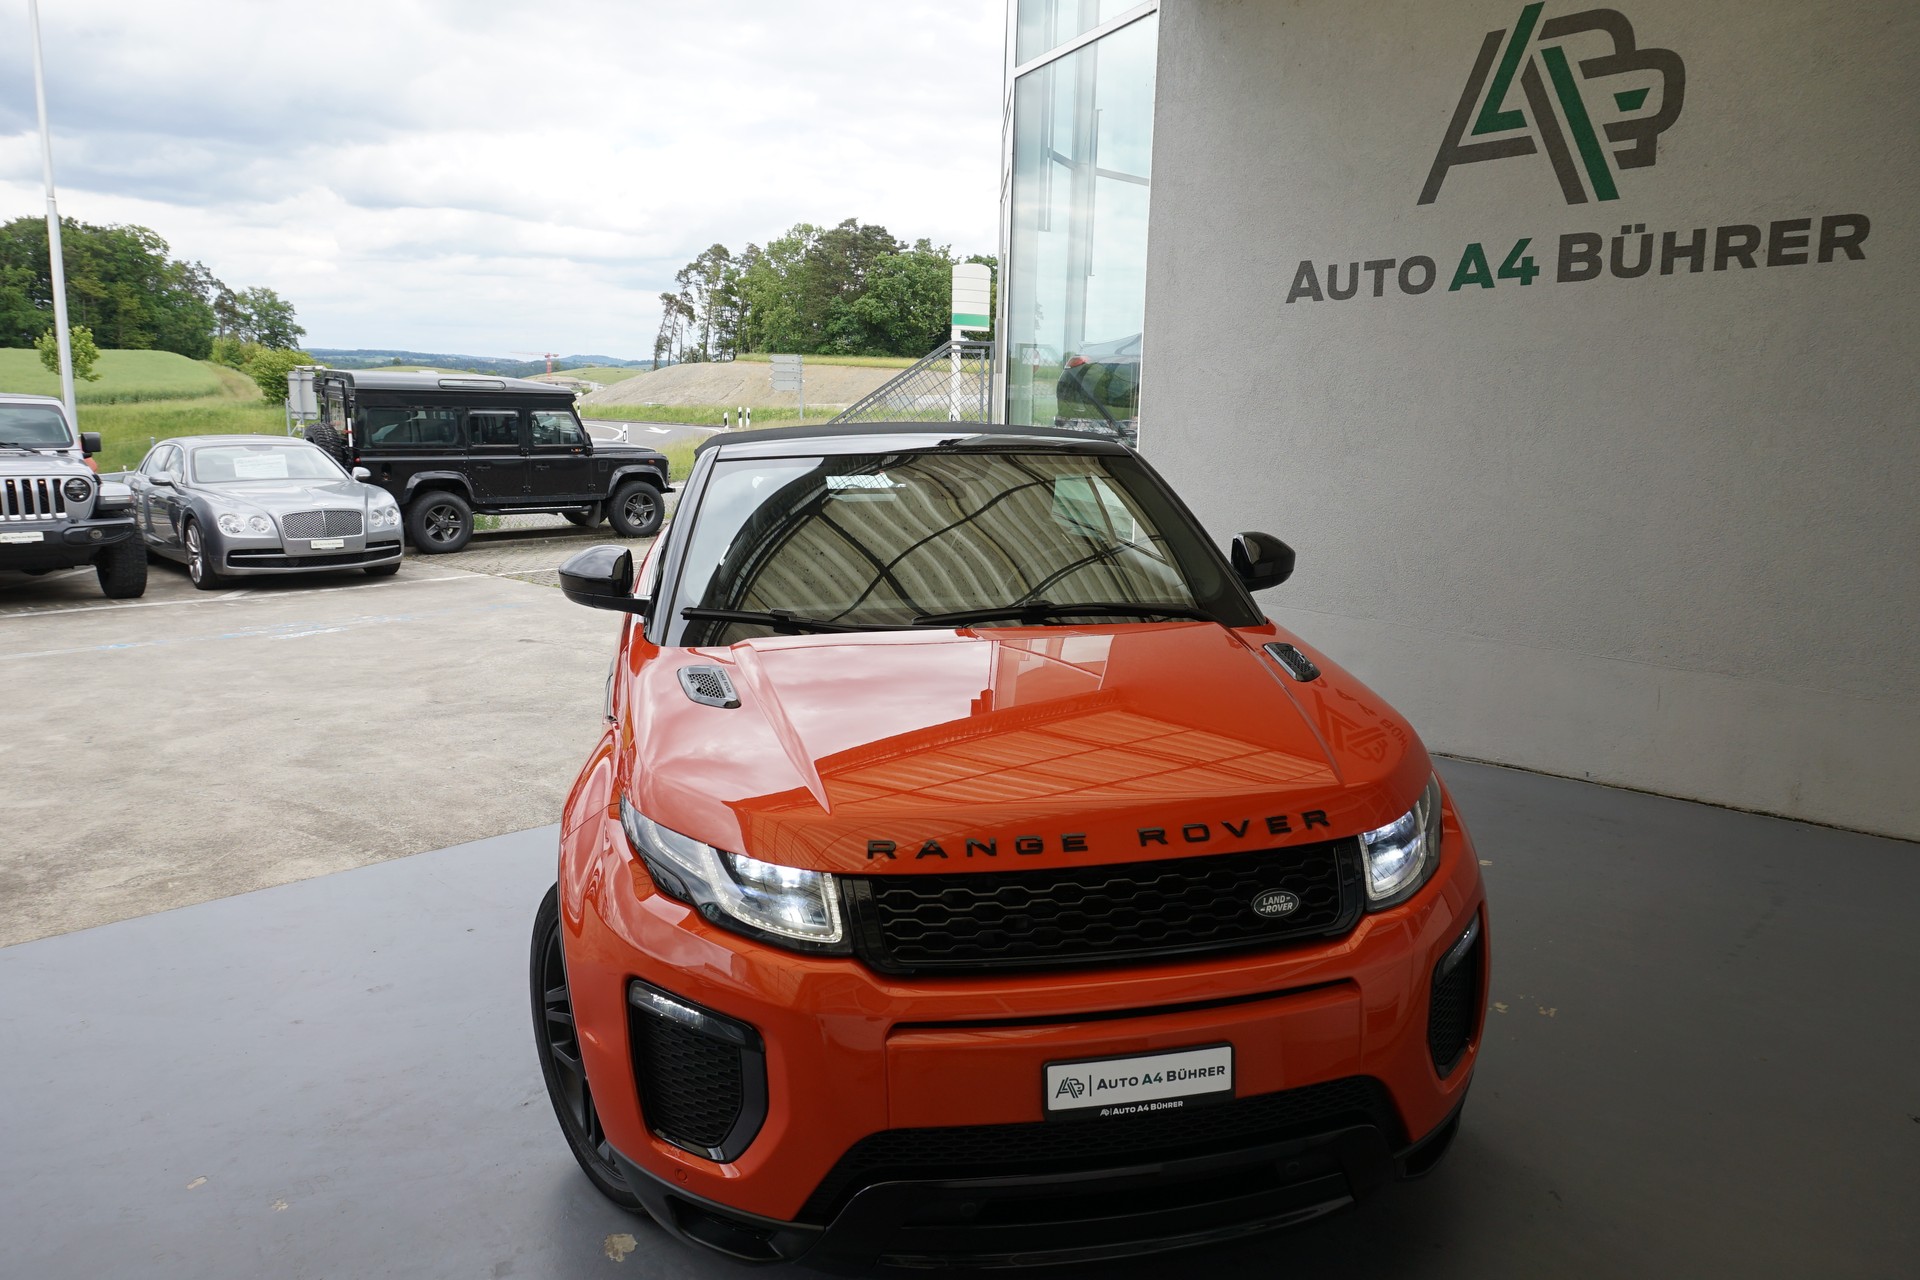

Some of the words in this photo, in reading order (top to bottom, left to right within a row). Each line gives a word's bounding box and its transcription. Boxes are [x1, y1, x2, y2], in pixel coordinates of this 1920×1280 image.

[1285, 255, 1437, 304] AUTO
[1447, 237, 1540, 292] A4
[1556, 213, 1872, 283] BÜHRER
[866, 832, 1089, 860] RANGE
[1137, 809, 1331, 848] ROVER
[1262, 895, 1286, 906] LAND
[1265, 902, 1293, 913] ROVER
[1096, 1076, 1139, 1090] AUTO
[1141, 1072, 1163, 1085] A4
[1166, 1065, 1226, 1082] BÜHRER
[1112, 1106, 1136, 1115] AUTO
[1136, 1104, 1149, 1112] A4
